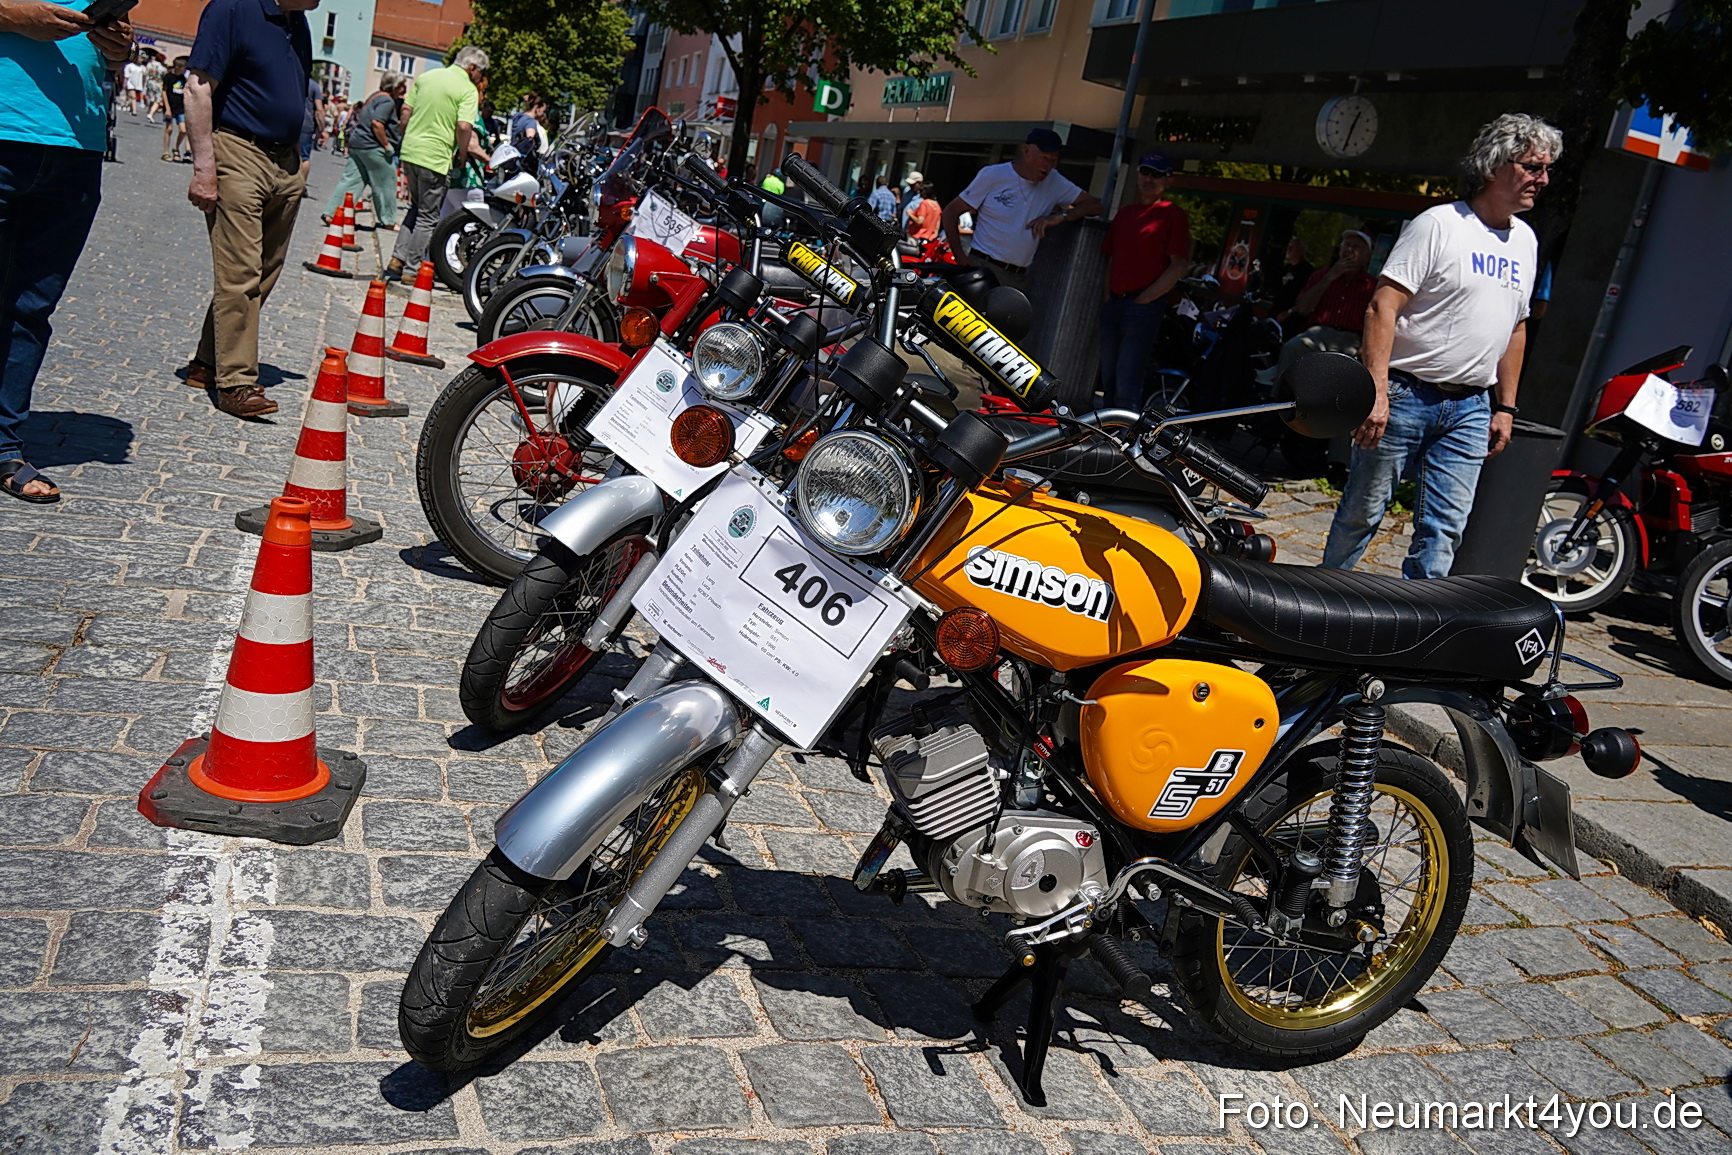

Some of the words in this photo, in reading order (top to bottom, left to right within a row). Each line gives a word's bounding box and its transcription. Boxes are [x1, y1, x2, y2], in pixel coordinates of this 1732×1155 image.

[820, 85, 844, 110] D
[663, 216, 684, 234] 535
[790, 246, 855, 302] PROTAPER
[1472, 252, 1520, 284] NOPE
[940, 299, 1038, 392] PROTAPER
[1676, 399, 1701, 413] 582
[690, 544, 712, 568] Teilnehmer
[774, 562, 854, 626] 406
[965, 546, 1114, 622] simson
[662, 580, 694, 614] Besonderheiten
[752, 611, 774, 629] Hersteller:
[757, 602, 784, 626] Fahrzeug
[739, 630, 760, 647] Hubraum:
[743, 624, 761, 640] Baujahr:
[1522, 640, 1538, 654] IFA
[1212, 753, 1235, 773] B
[1205, 778, 1226, 793] 51
[1021, 861, 1037, 882] 4
